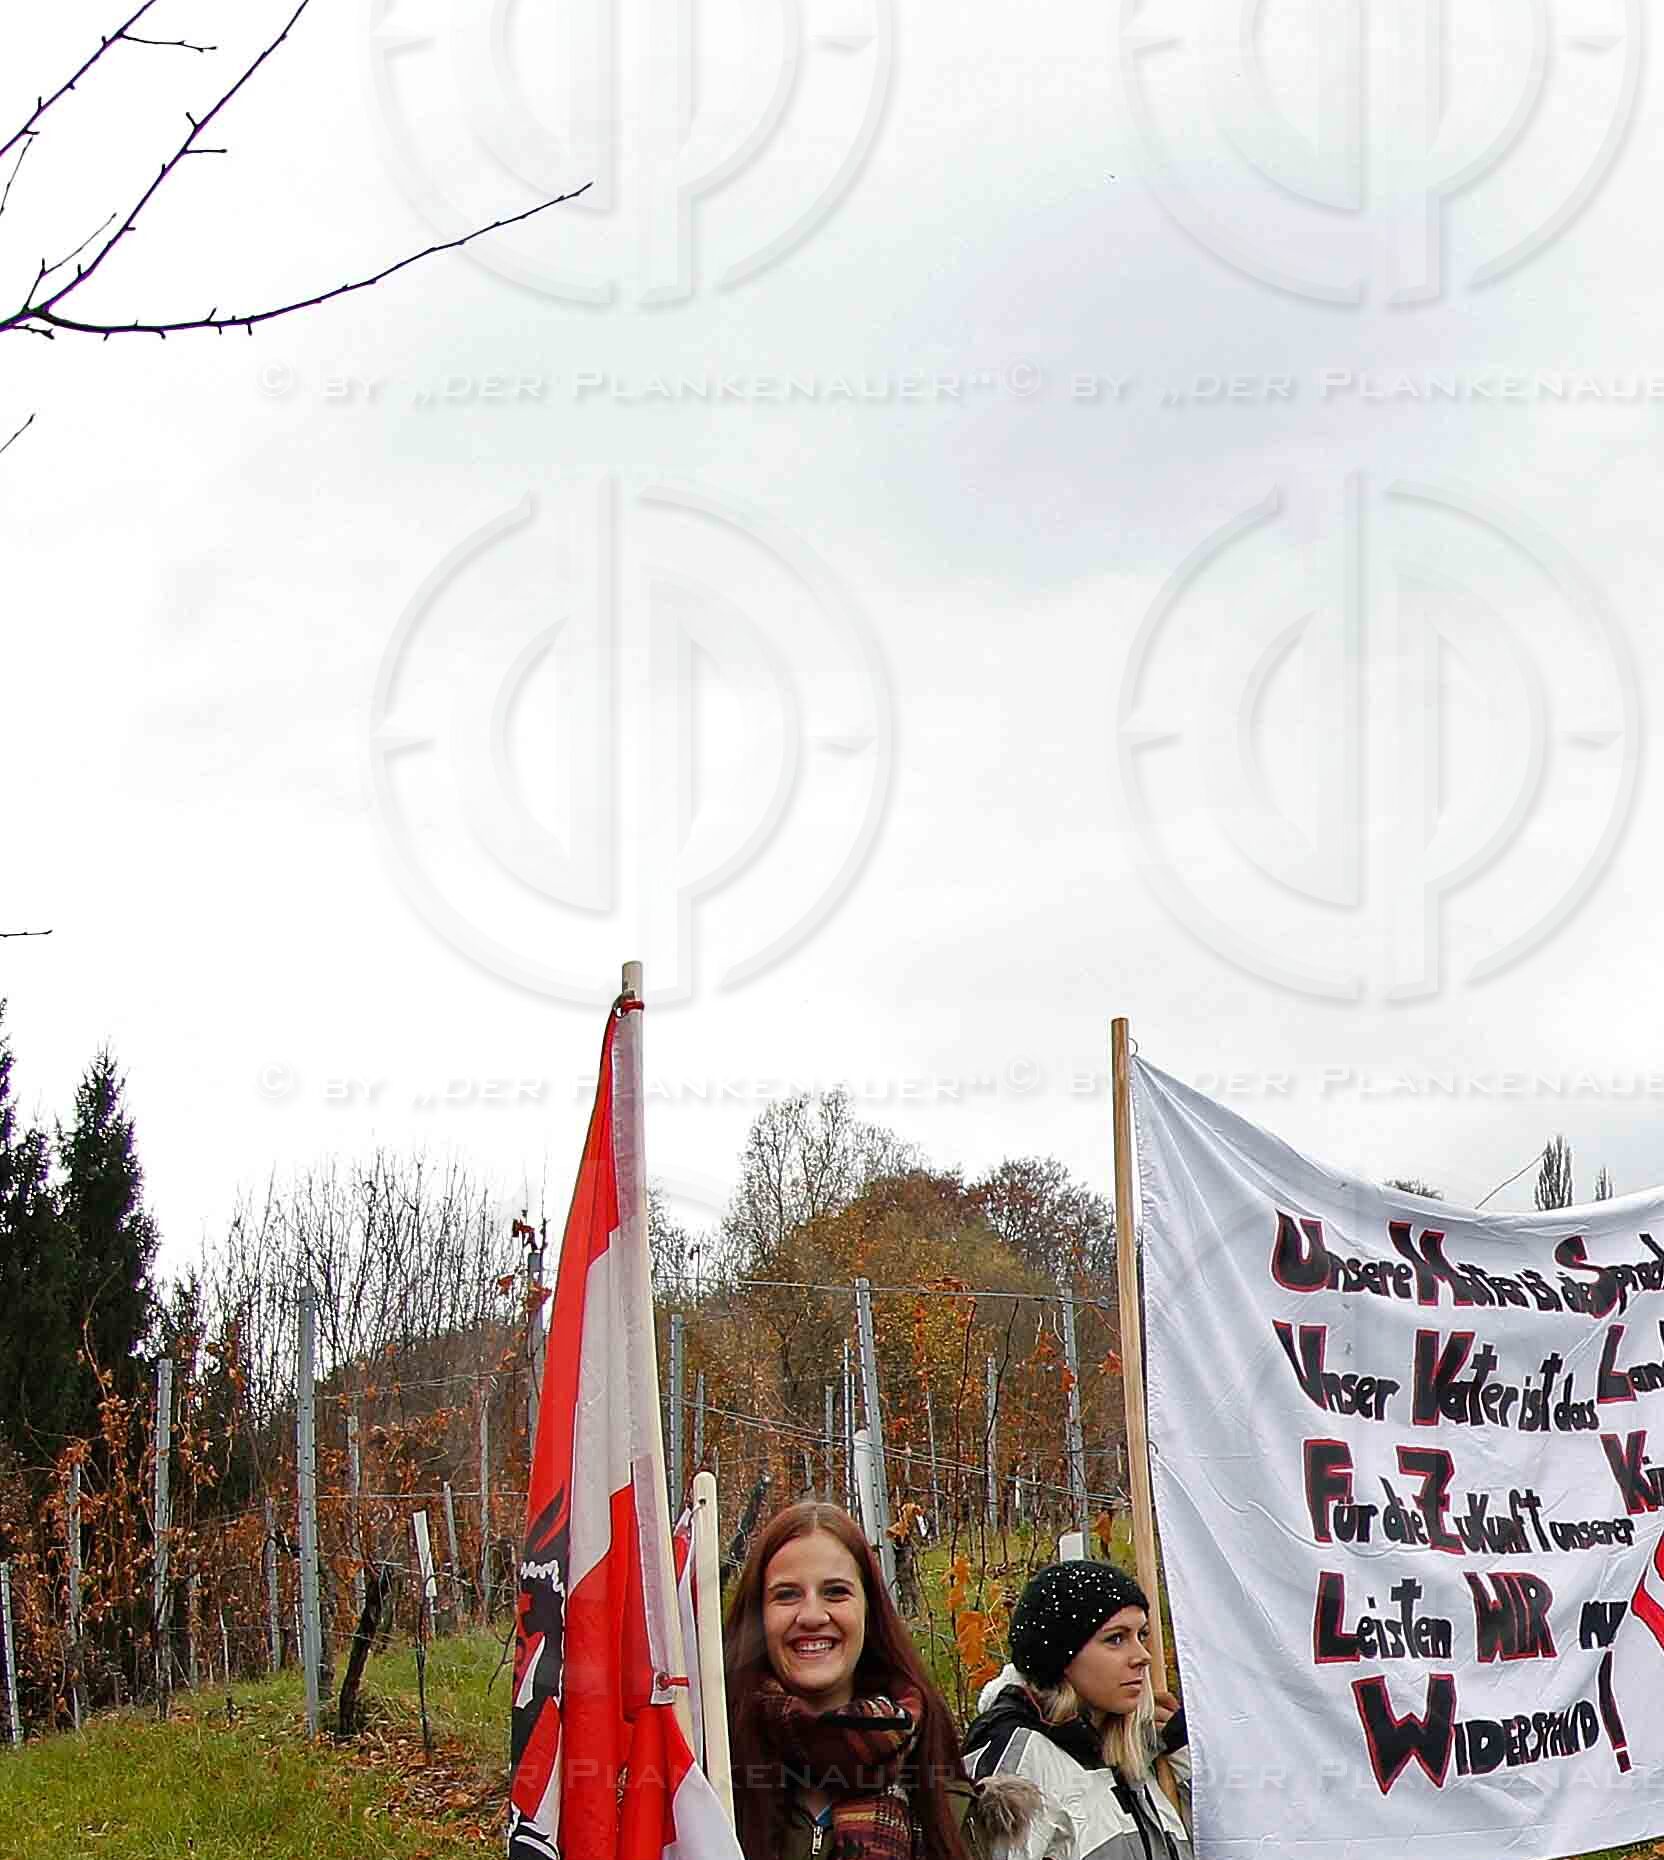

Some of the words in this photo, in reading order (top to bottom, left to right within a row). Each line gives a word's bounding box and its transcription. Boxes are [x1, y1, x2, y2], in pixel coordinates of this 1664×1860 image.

[1271, 1319, 1400, 1422] Unser
[1412, 1328, 1519, 1427] Vater
[1554, 1372, 1600, 1432] das
[1378, 1475, 1430, 1546] die
[1314, 1570, 1453, 1665] Leisten
[1462, 1570, 1558, 1664] WIR
